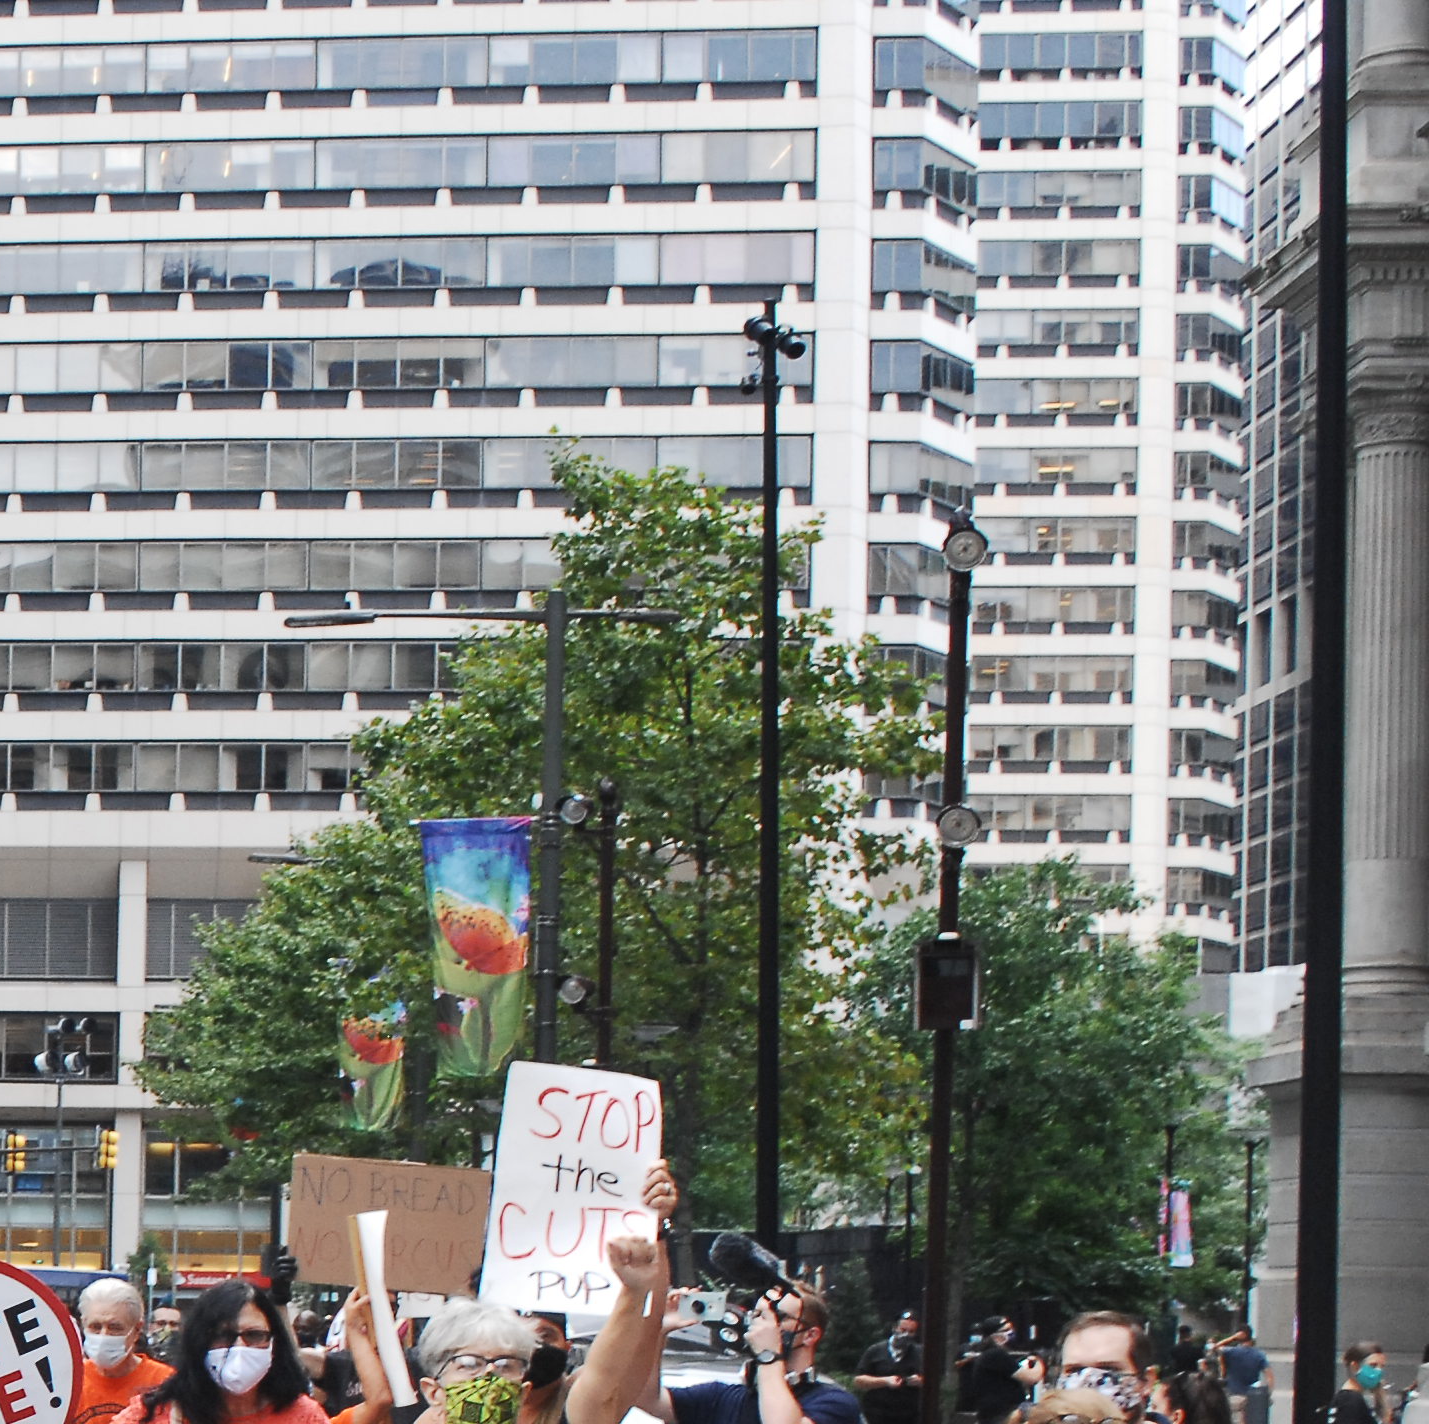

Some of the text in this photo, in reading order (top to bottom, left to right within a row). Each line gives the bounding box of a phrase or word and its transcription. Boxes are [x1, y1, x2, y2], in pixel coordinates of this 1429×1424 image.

[529, 1087, 656, 1153] STOP
[301, 1165, 477, 1216] NO BREAD
[541, 1154, 623, 1197] the
[294, 1227, 342, 1267] NO
